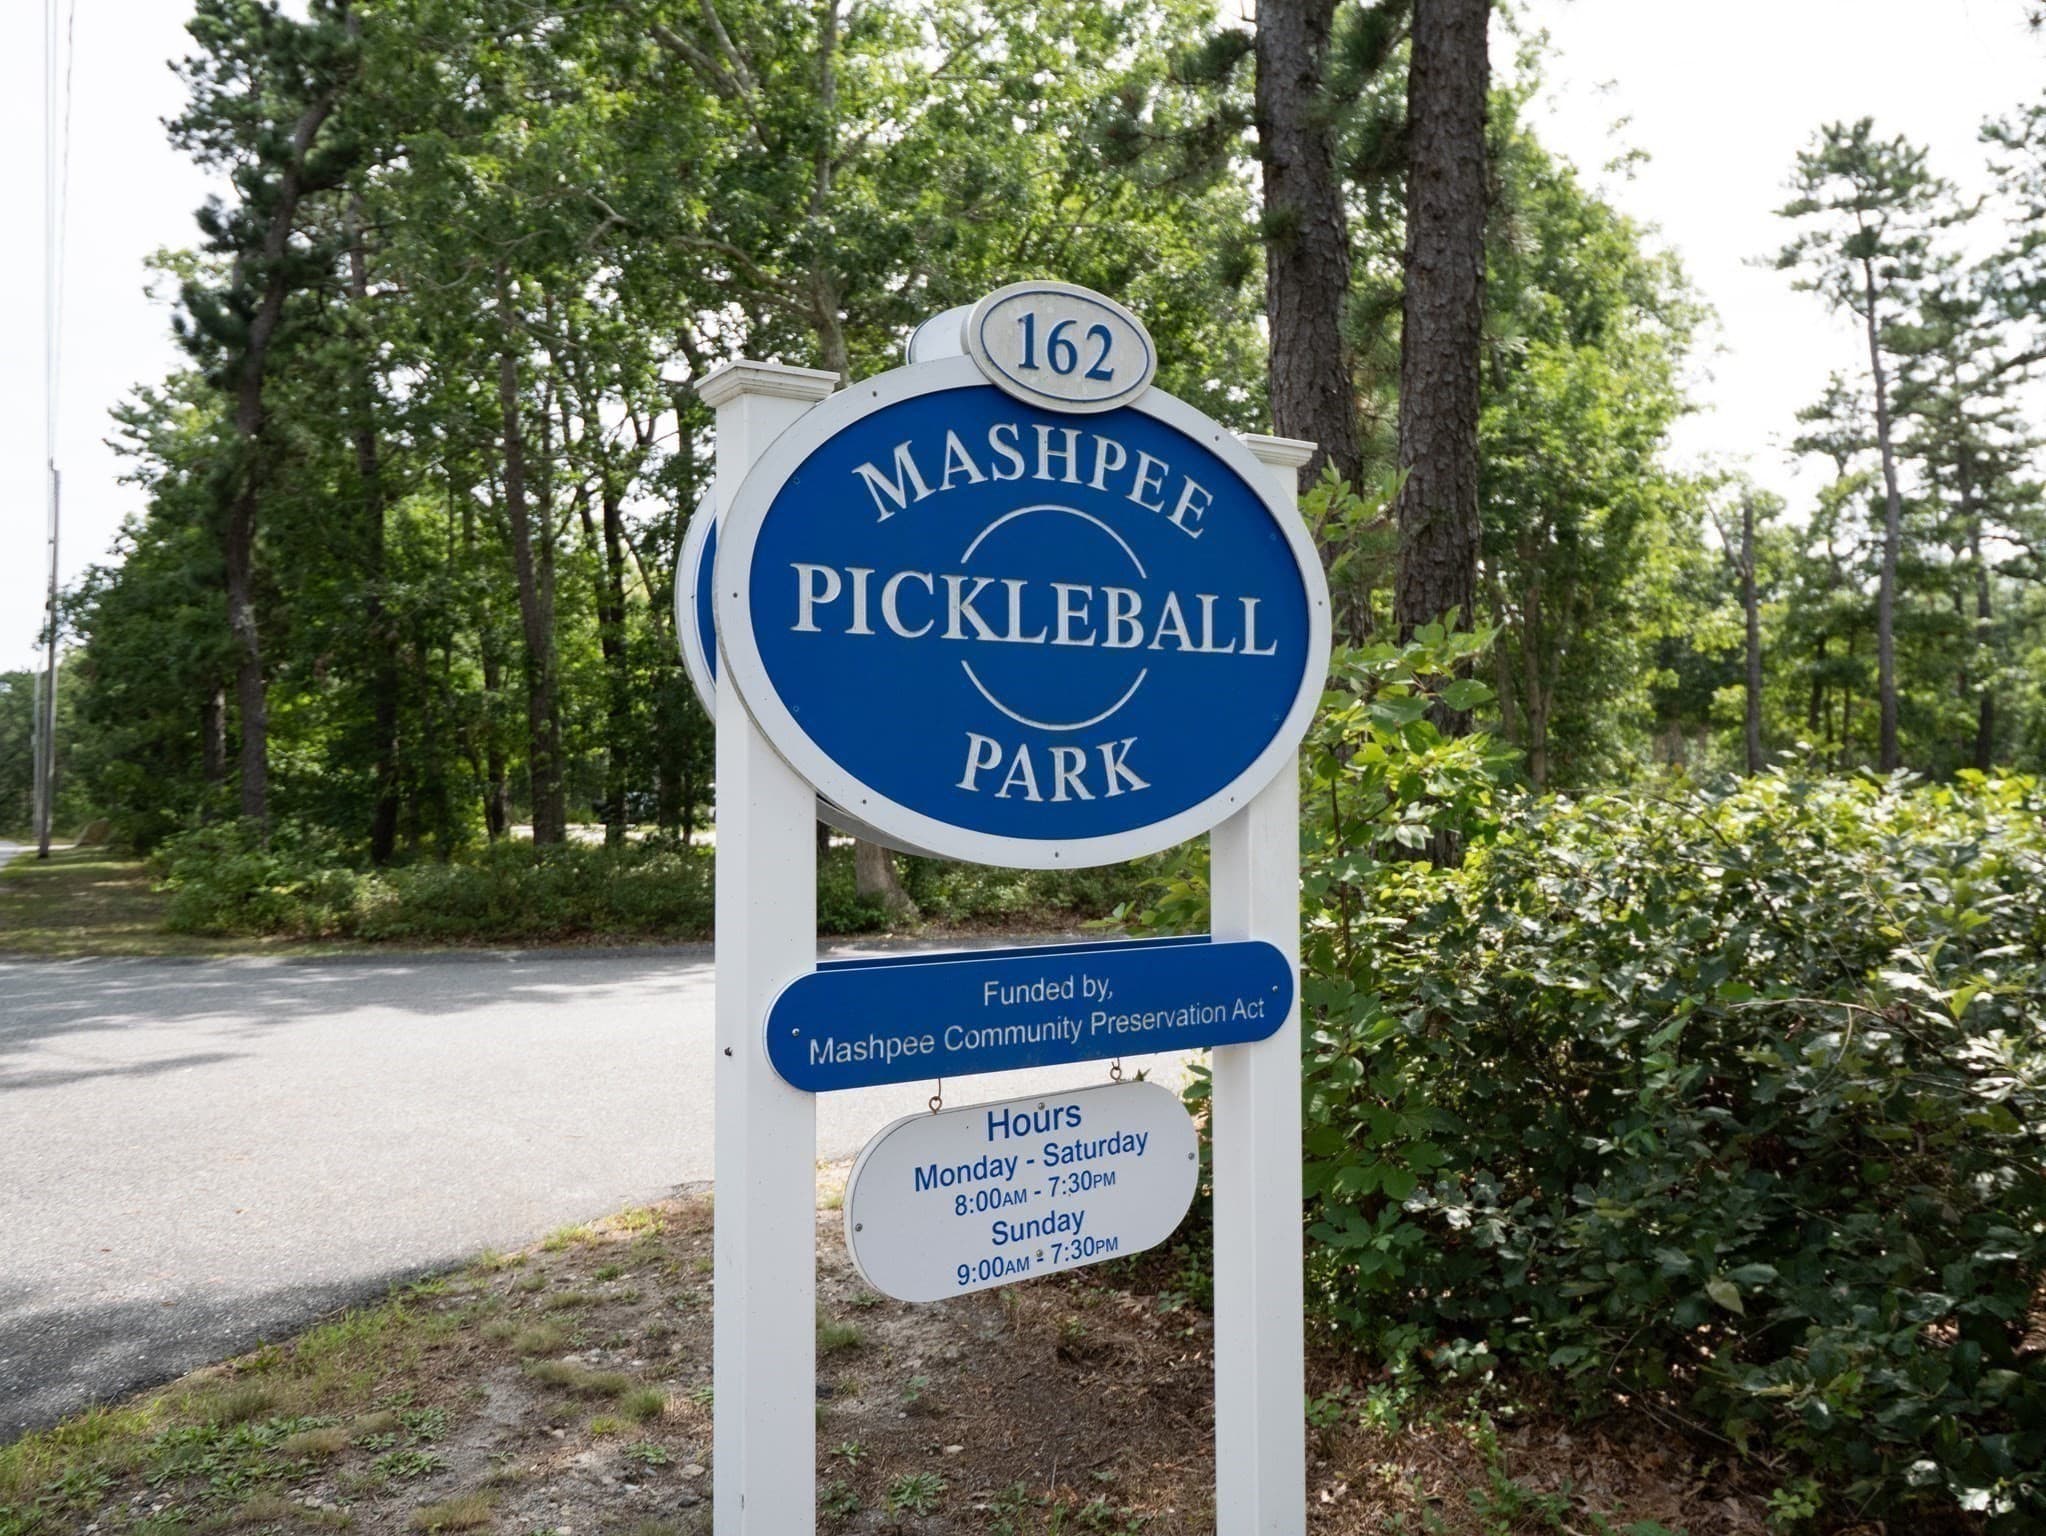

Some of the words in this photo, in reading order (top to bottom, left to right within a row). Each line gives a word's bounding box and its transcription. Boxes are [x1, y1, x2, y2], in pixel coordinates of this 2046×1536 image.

[1017, 312, 1115, 383] 162
[852, 423, 1213, 539] MASHPEE
[790, 563, 1277, 656] PICKLEBALL
[956, 732, 1151, 802] PARK
[984, 976, 1074, 1006] Funded
[1083, 974, 1113, 1002] by,
[809, 1034, 935, 1065] Mashpee
[944, 1016, 1082, 1051] Community
[1091, 1004, 1227, 1035] Preservation
[1232, 997, 1265, 1020] Act
[987, 1104, 1083, 1142] Hours
[914, 1154, 1019, 1193] Monday
[1043, 1131, 1149, 1168] Saturday
[954, 1187, 1028, 1217] 8:00AM
[1047, 1170, 1116, 1198] 7:30PM
[991, 1209, 1086, 1247] Sunday
[956, 1255, 1030, 1287] 9:00AM
[1050, 1236, 1119, 1265] 7:30PM
